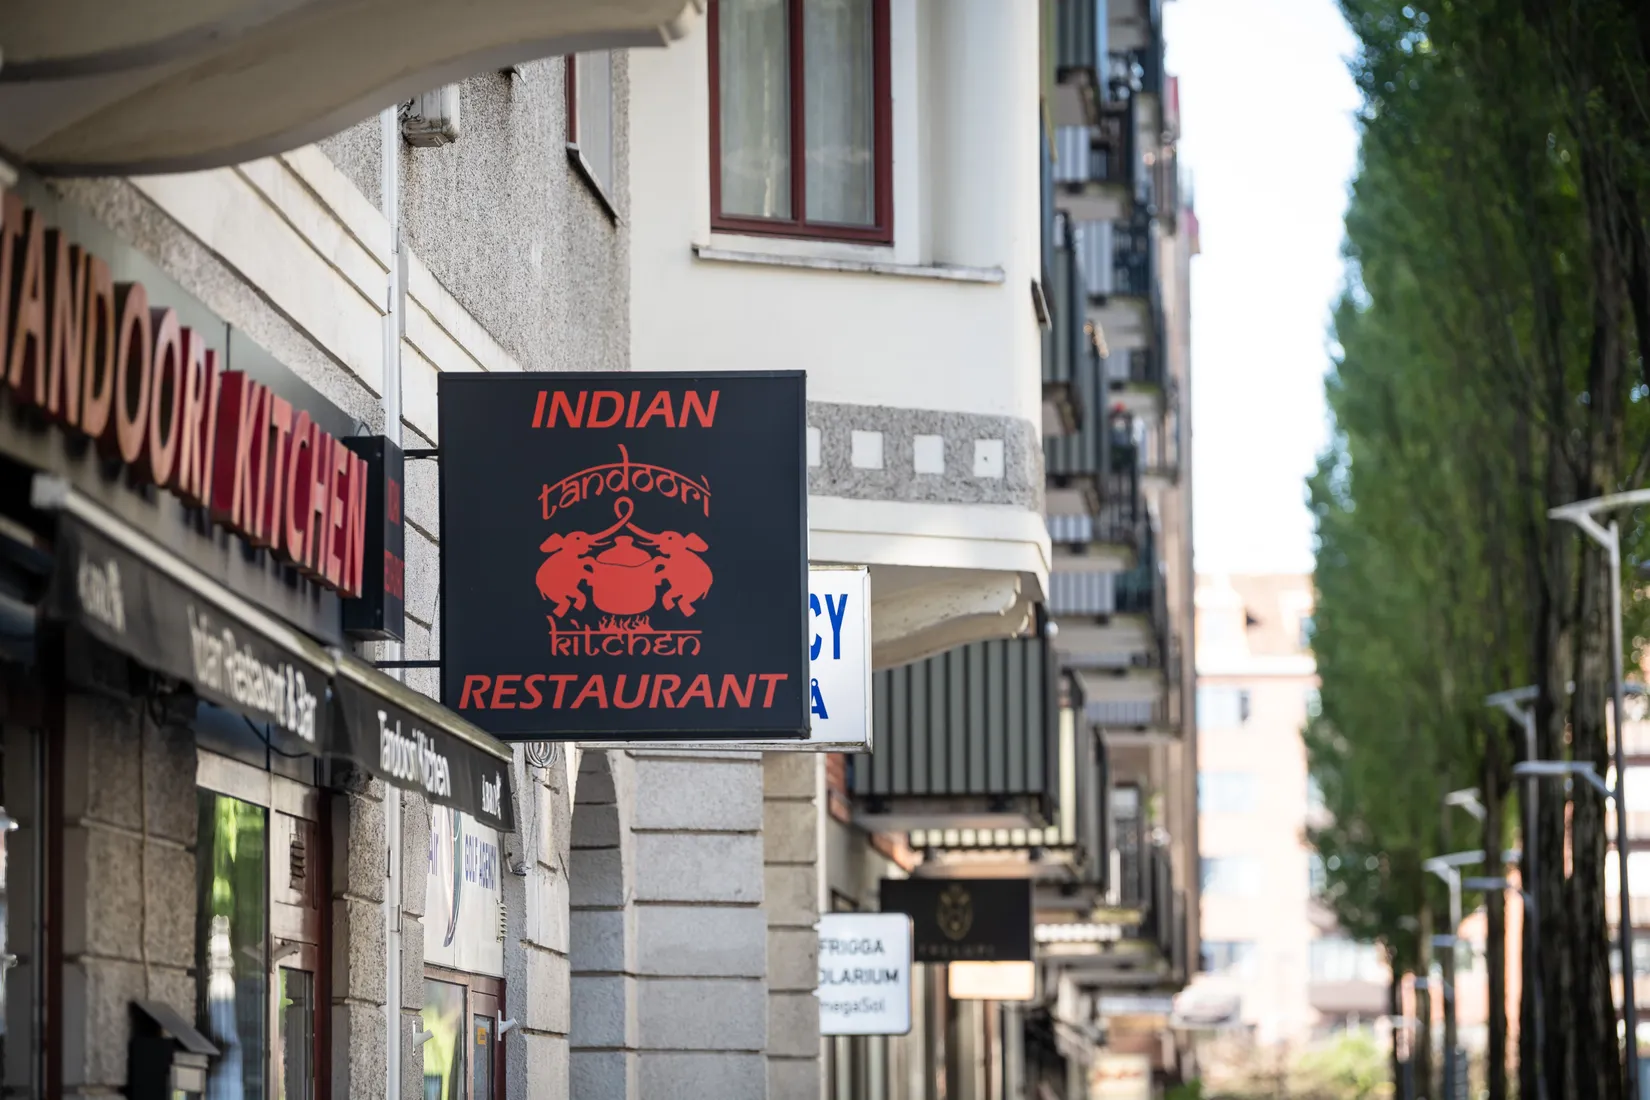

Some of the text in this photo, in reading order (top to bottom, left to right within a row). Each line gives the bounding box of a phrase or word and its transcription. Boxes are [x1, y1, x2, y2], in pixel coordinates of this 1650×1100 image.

[0, 194, 369, 599] TANDOORI KITCHEN
[531, 390, 720, 428] INDIAN
[538, 444, 711, 520] tandoori
[546, 615, 702, 657] kitchen
[459, 673, 789, 710] RESTAURANT
[378, 710, 418, 782] Tandoori
[417, 730, 451, 798] Kitchen
